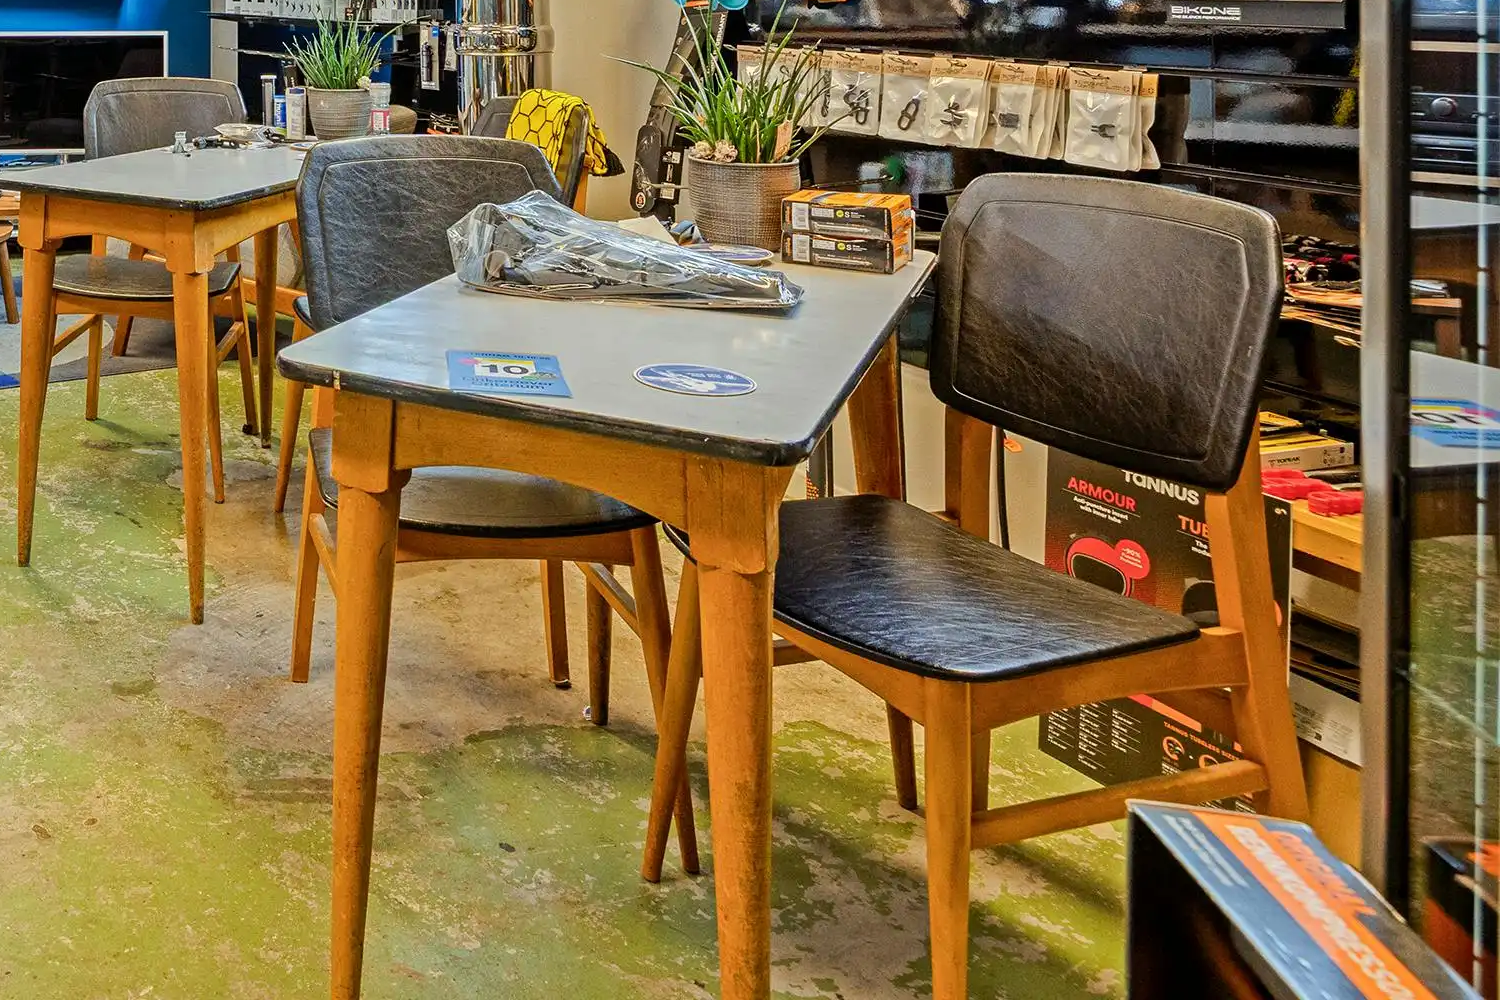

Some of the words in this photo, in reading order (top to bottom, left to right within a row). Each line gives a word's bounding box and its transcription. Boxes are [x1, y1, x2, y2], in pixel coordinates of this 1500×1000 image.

[1171, 5, 1241, 15] BIKONE
[714, 13, 726, 45] GERMANY
[481, 364, 529, 375] 10
[1067, 476, 1137, 512] ARMOUR
